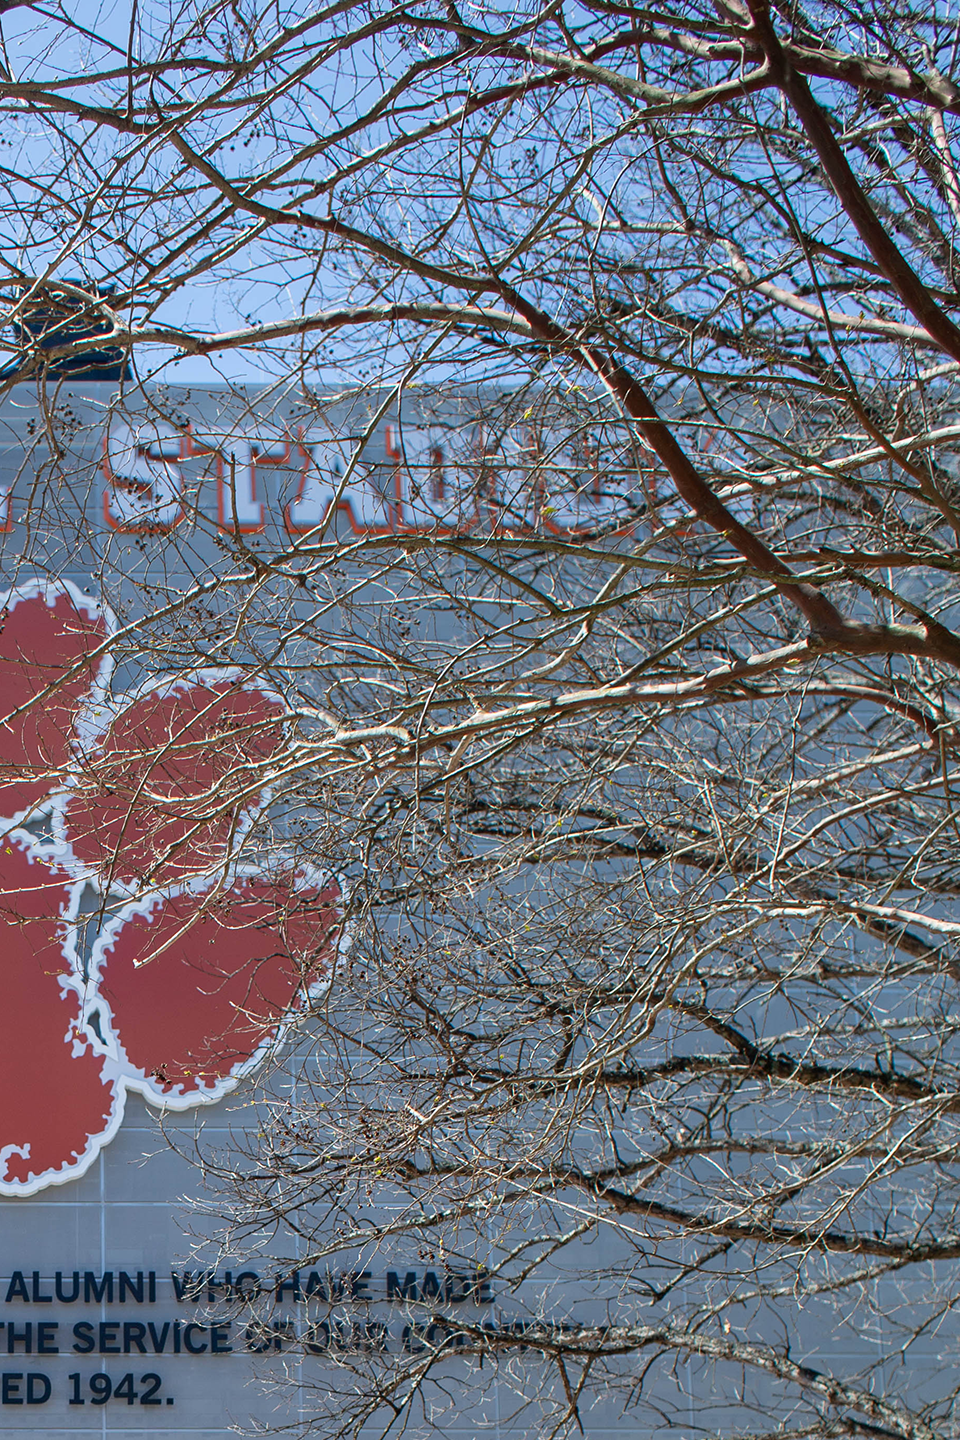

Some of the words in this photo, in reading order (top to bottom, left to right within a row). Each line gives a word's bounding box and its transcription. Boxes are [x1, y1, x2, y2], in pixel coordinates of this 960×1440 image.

[5, 1271, 156, 1303] ALUMNI
[171, 1270, 261, 1303] WHO
[275, 1271, 373, 1303] HAVE
[387, 1271, 496, 1304] MADE
[72, 1320, 233, 1354] SERVICE
[245, 1321, 294, 1354] OF
[68, 1372, 175, 1406] 1942.
